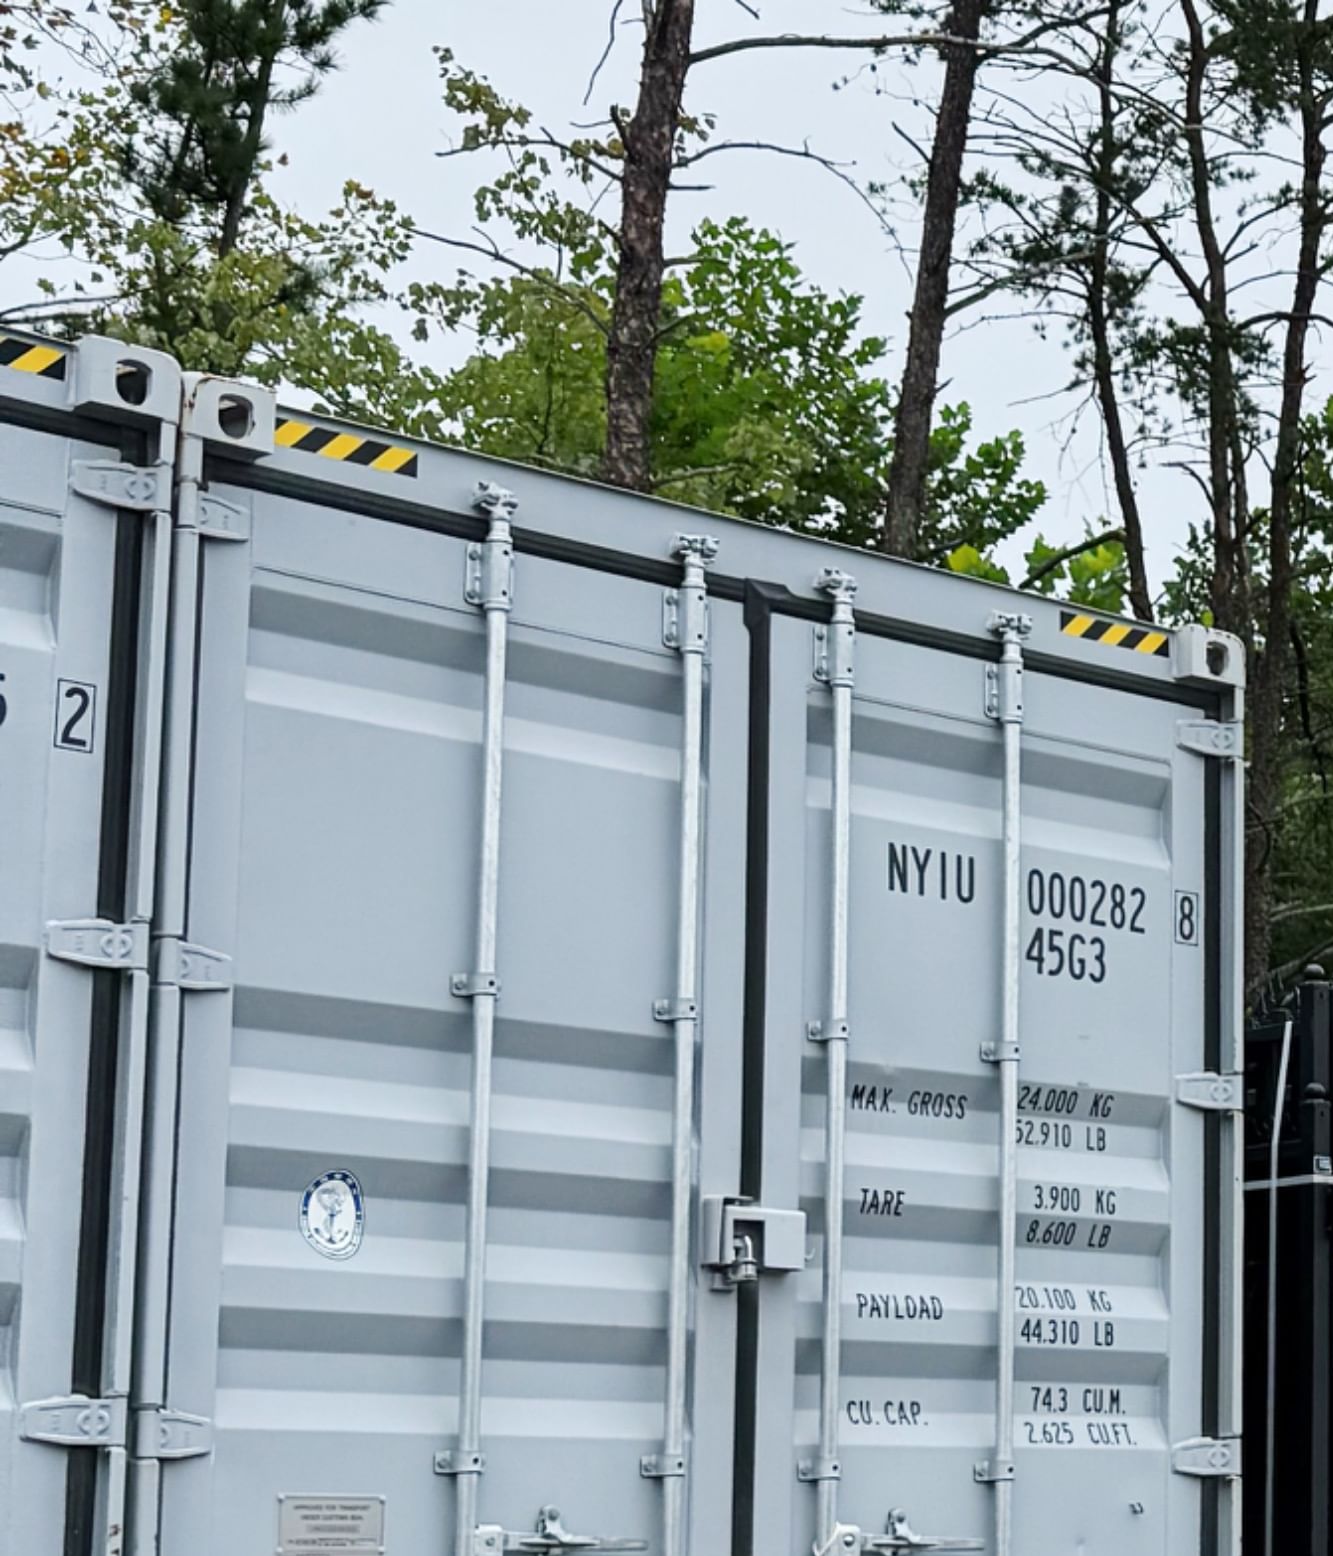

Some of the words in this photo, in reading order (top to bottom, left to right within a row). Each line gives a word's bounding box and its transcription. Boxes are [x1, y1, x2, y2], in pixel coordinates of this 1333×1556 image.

[61, 687, 90, 748] 2
[887, 841, 975, 904] NYIU
[1027, 868, 1147, 935] 000282
[1180, 896, 1194, 941] 8
[1025, 926, 1107, 984] 45G3
[851, 1084, 896, 1114] MAX.
[907, 1090, 968, 1120] GROSS
[1017, 1086, 1078, 1115] 24.000
[1089, 1092, 1115, 1118] KG
[1086, 1125, 1106, 1152] LB
[860, 1188, 905, 1217] TARE
[1033, 1184, 1081, 1212] 3.900
[1094, 1189, 1117, 1215] KG
[1026, 1218, 1076, 1247] 8.600
[1087, 1223, 1112, 1249] LB
[856, 1293, 944, 1320] PAYLOAD
[1015, 1286, 1076, 1311] 20.100
[1087, 1289, 1113, 1313] KG
[1020, 1318, 1080, 1345] 44.310
[1094, 1321, 1115, 1347] LB
[1030, 1386, 1068, 1413] 74.3
[1082, 1387, 1127, 1415] CU.M.
[1023, 1421, 1075, 1445] 2.625
